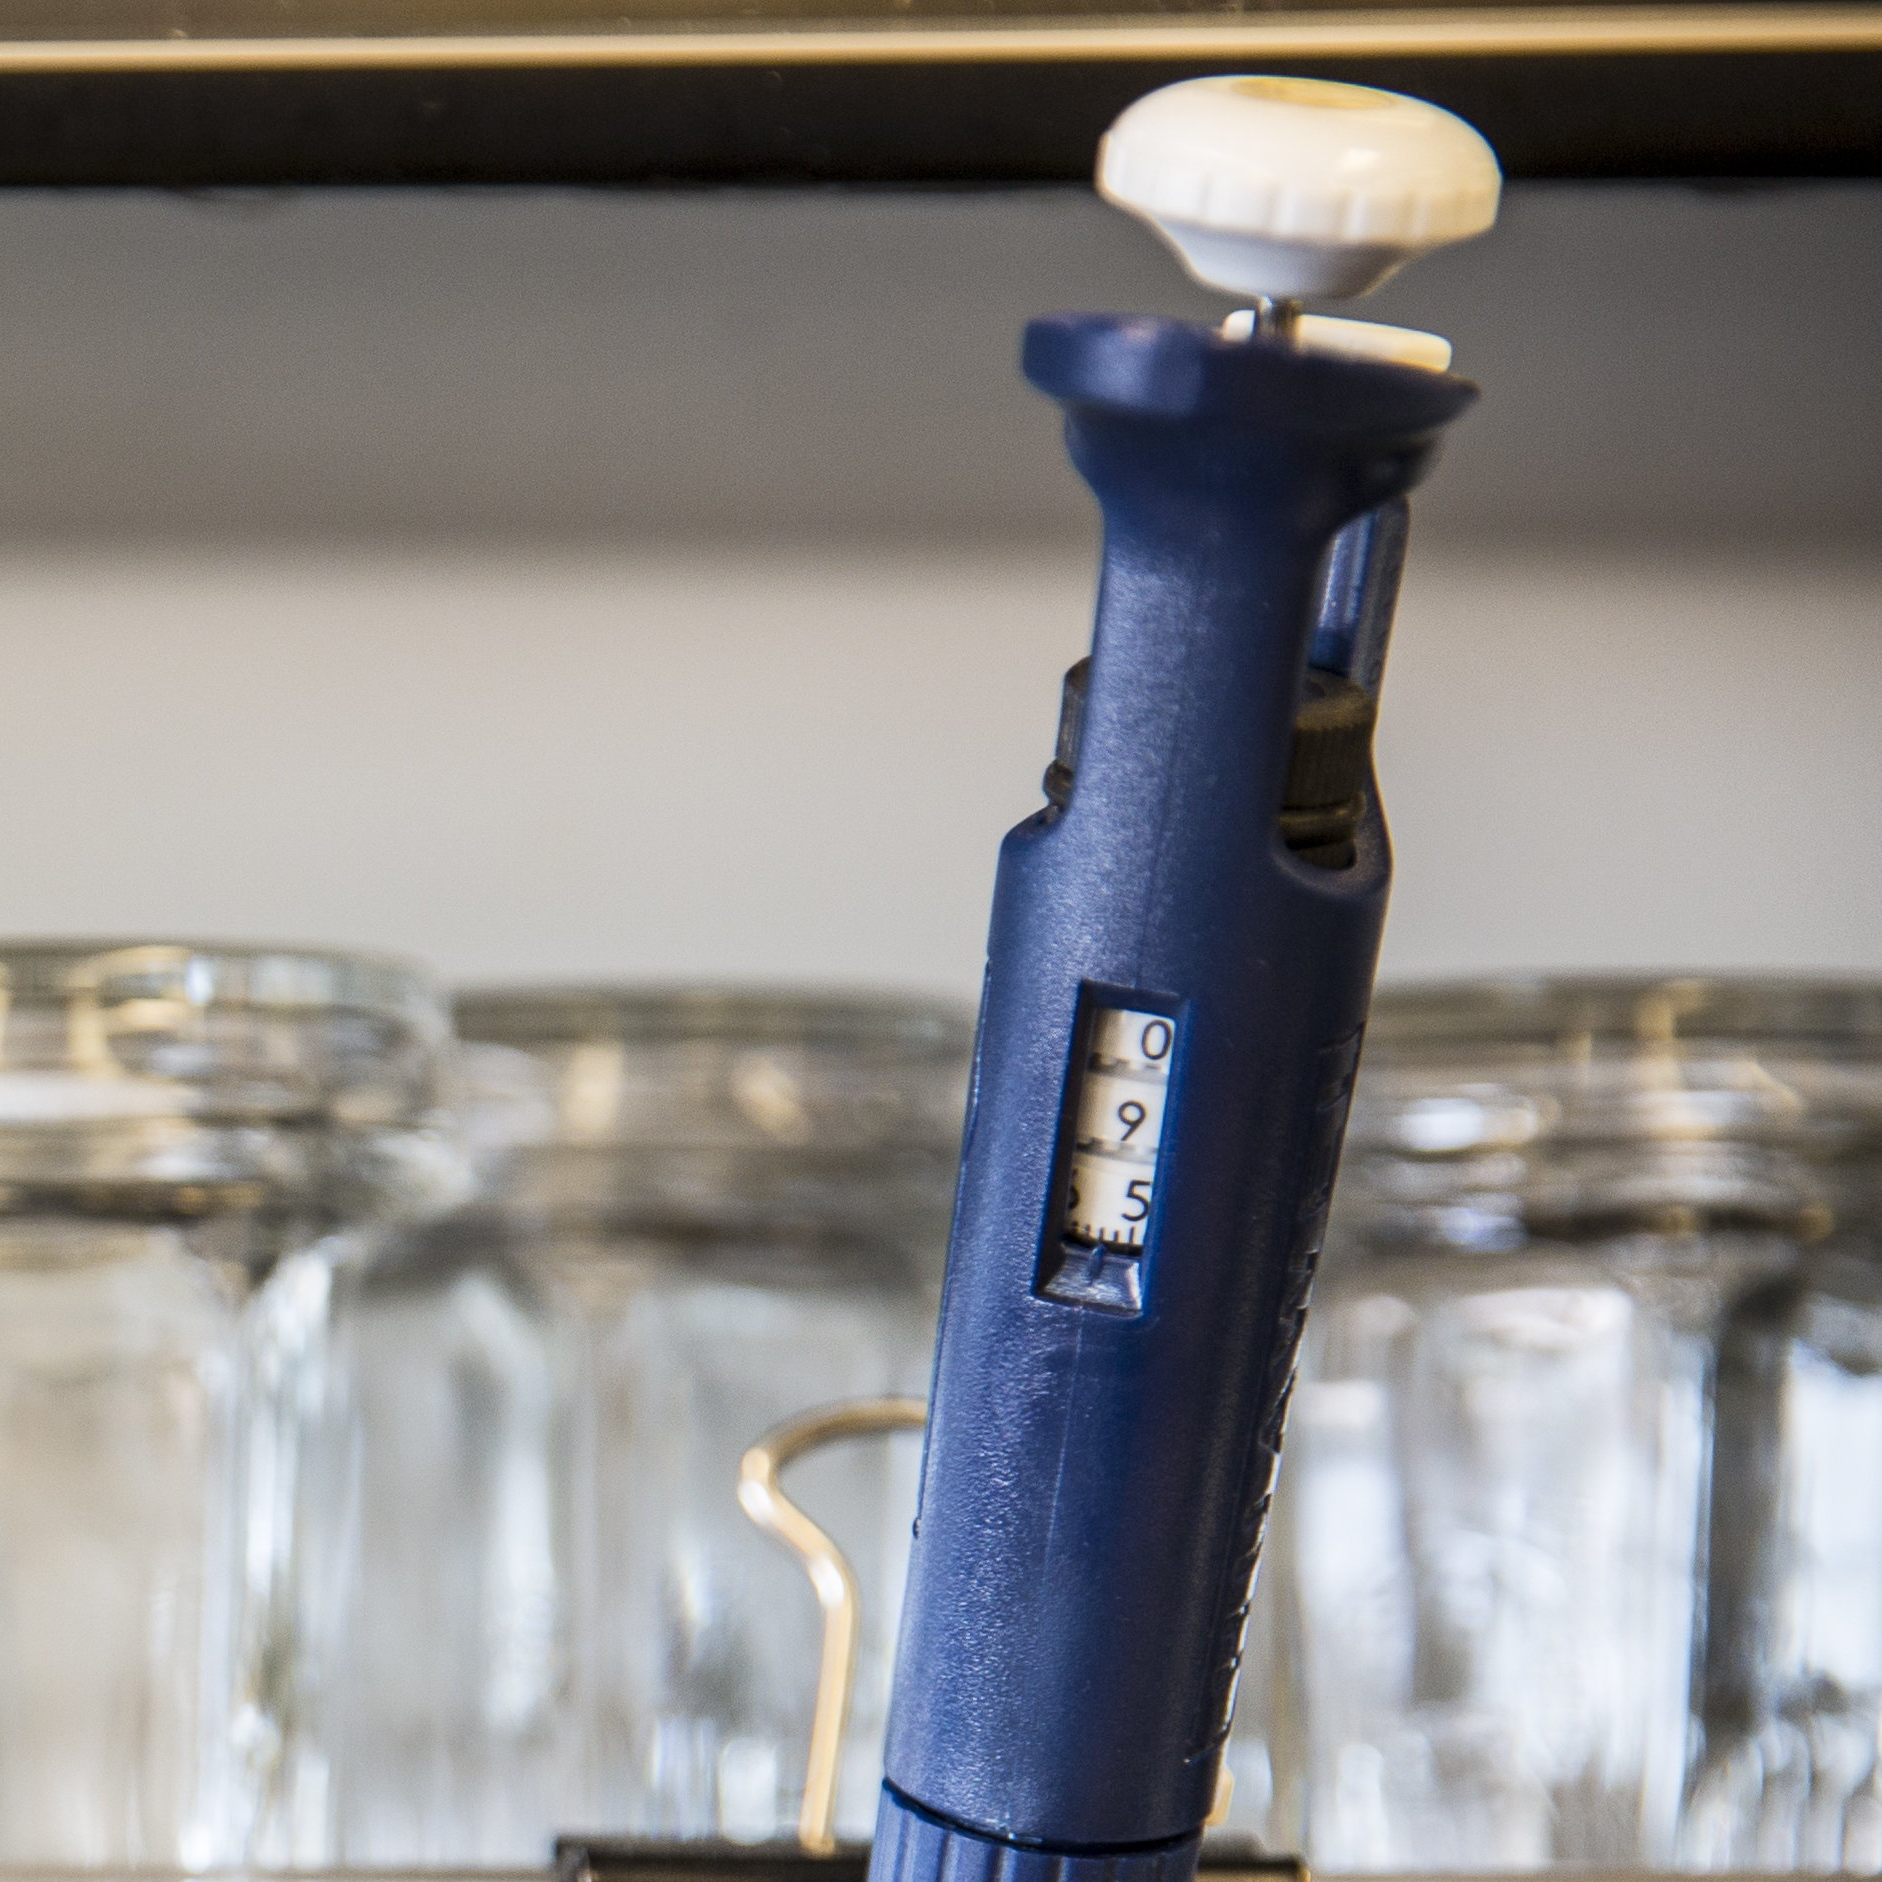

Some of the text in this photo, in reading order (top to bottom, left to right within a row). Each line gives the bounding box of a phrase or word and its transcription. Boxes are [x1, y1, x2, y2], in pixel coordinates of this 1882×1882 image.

[1141, 1019, 1173, 1060] 0
[1118, 1100, 1147, 1142] 9
[1121, 1179, 1153, 1222] 5
